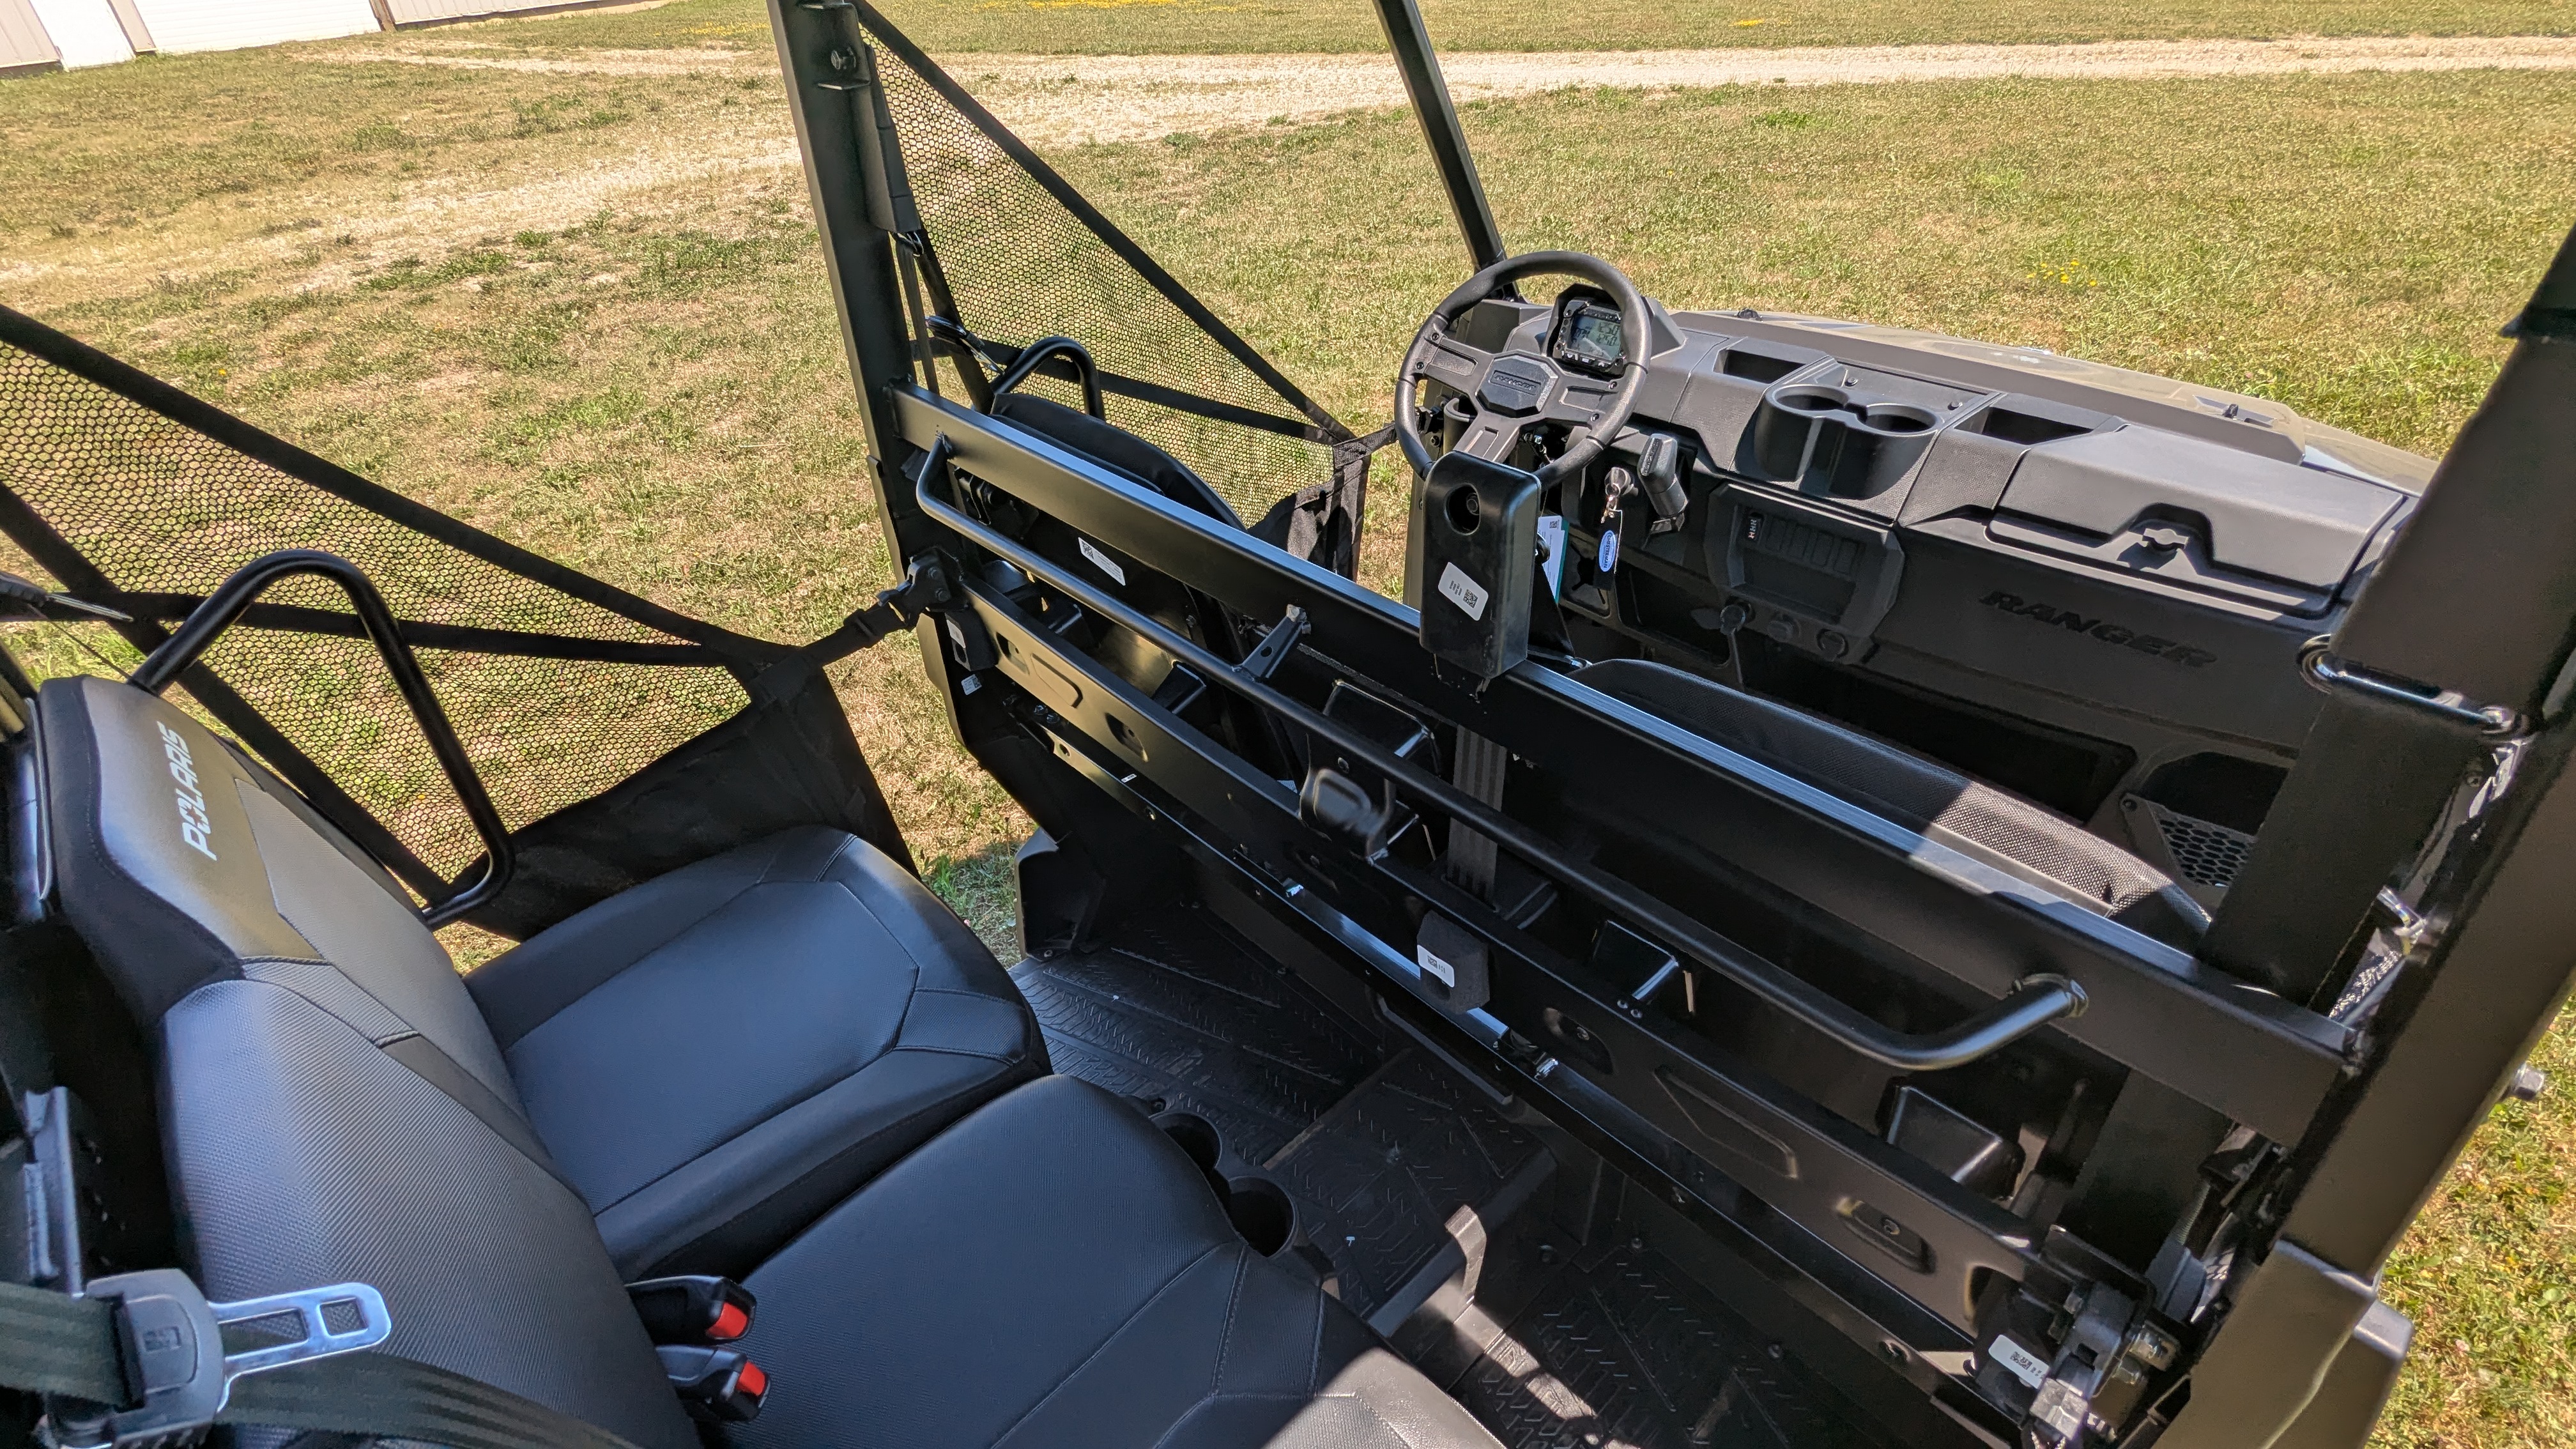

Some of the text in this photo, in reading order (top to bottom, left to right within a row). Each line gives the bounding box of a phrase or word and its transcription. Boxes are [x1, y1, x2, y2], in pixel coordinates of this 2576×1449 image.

[1494, 374, 1537, 391] RANGER
[1979, 590, 2218, 668] RANGER
[157, 721, 217, 861] POLARIS
